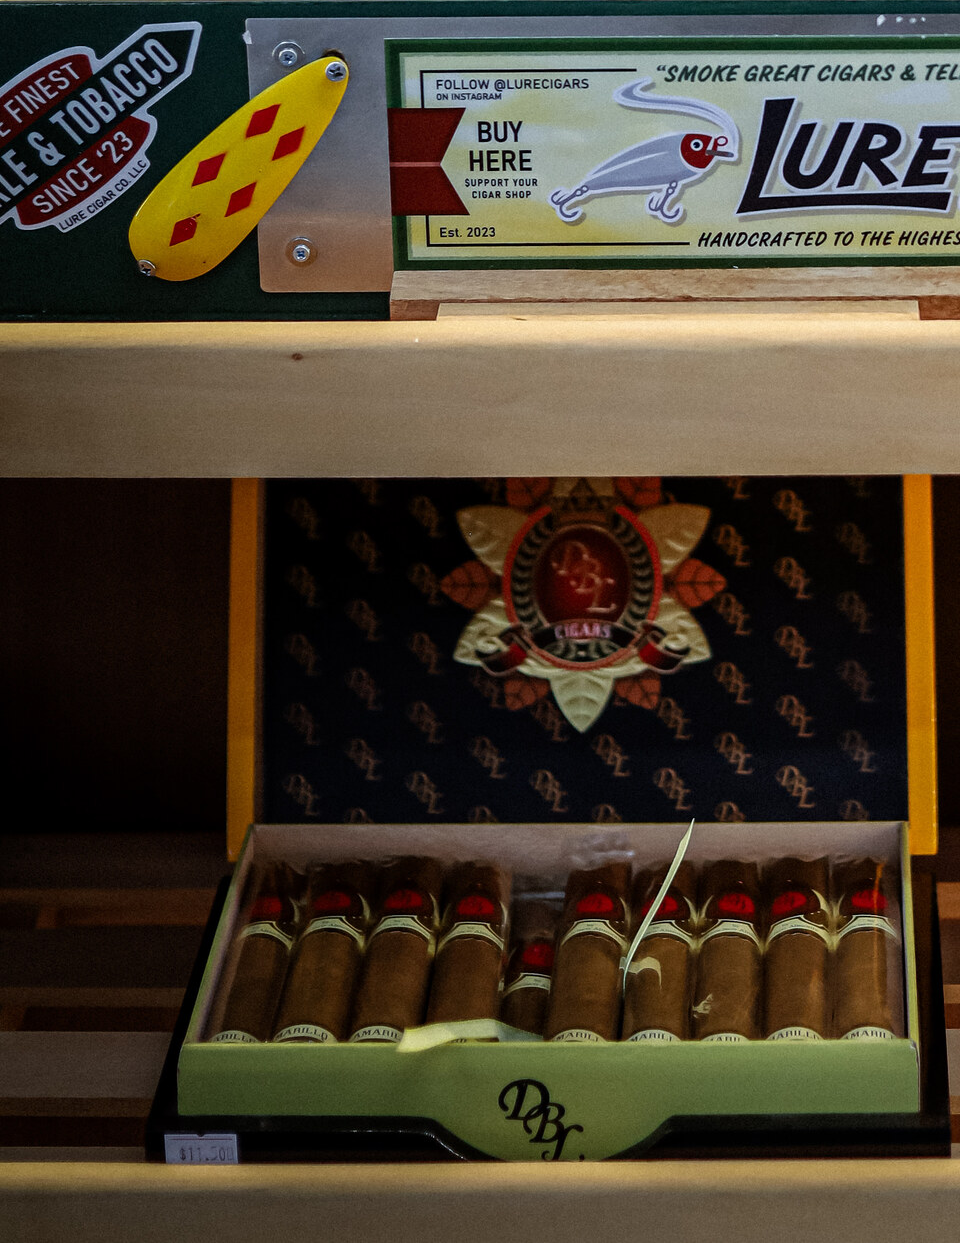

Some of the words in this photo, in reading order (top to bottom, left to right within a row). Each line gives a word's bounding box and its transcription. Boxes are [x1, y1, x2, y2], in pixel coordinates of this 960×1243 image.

[656, 64, 741, 83] "SMOKE
[744, 64, 815, 83] GREAT
[817, 63, 896, 83] CIGARS
[899, 64, 916, 82] &
[3, 61, 81, 124] FINEST
[435, 78, 490, 91] FOLLOW
[494, 78, 589, 93] @LURECIGARS
[26, 131, 66, 167] &
[49, 38, 179, 146] TOBACCO
[436, 92, 450, 101] ON
[451, 92, 503, 101] INSTAGRAM
[477, 120, 523, 143] BUY
[469, 149, 533, 172] HERE
[32, 158, 103, 214] SINCE
[512, 177, 539, 187] YOUR
[58, 210, 88, 231] LURE
[86, 189, 117, 214] CIGAR
[114, 177, 132, 194] CO.
[127, 160, 147, 181] LLC
[471, 190, 502, 199] CIGAR
[505, 190, 532, 199] SHOP
[439, 227, 462, 238] Est.
[466, 227, 496, 238] 2023
[697, 231, 828, 248] HANDCRAFTED
[833, 231, 855, 247] TO
[860, 231, 896, 246] THE
